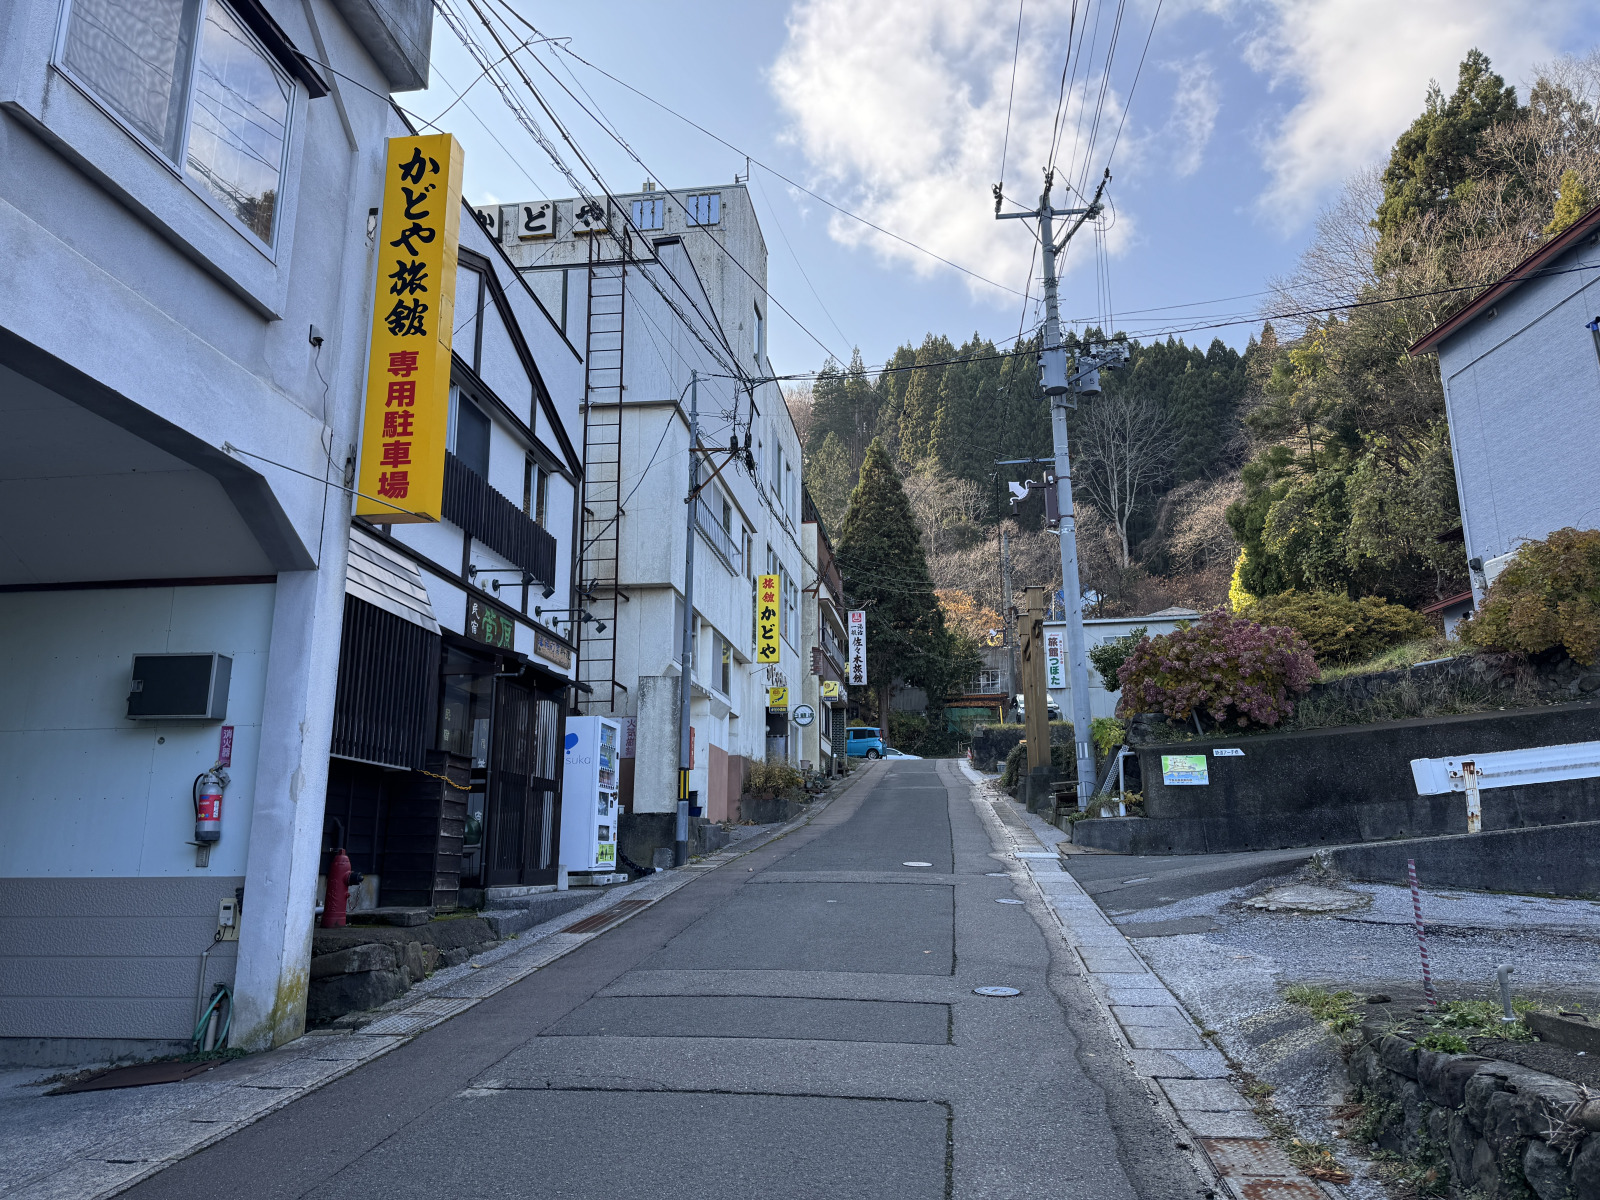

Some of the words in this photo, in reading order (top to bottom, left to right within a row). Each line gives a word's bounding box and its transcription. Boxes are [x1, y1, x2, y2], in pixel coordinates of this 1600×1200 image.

[384, 147, 440, 337] かどや旅館
[377, 350, 419, 499] 専用駐車場
[221, 729, 232, 757] 消火器
[565, 755, 591, 764] suka
